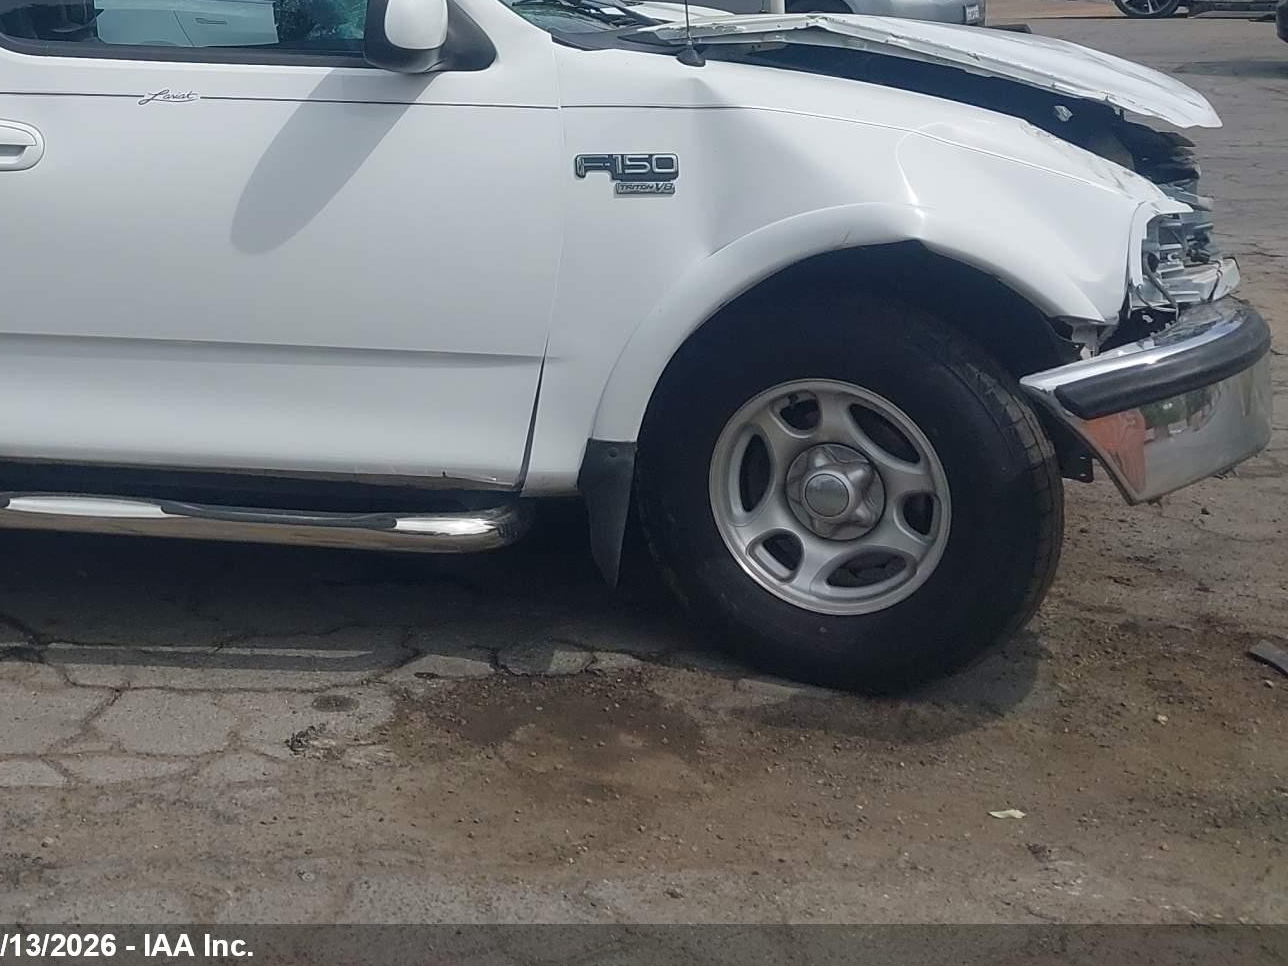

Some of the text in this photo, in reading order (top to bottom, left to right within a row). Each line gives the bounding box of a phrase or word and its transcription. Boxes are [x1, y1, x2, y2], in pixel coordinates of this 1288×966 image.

[138, 89, 198, 105] Lariat
[575, 153, 678, 178] F-150
[618, 183, 674, 193] TRITON V8
